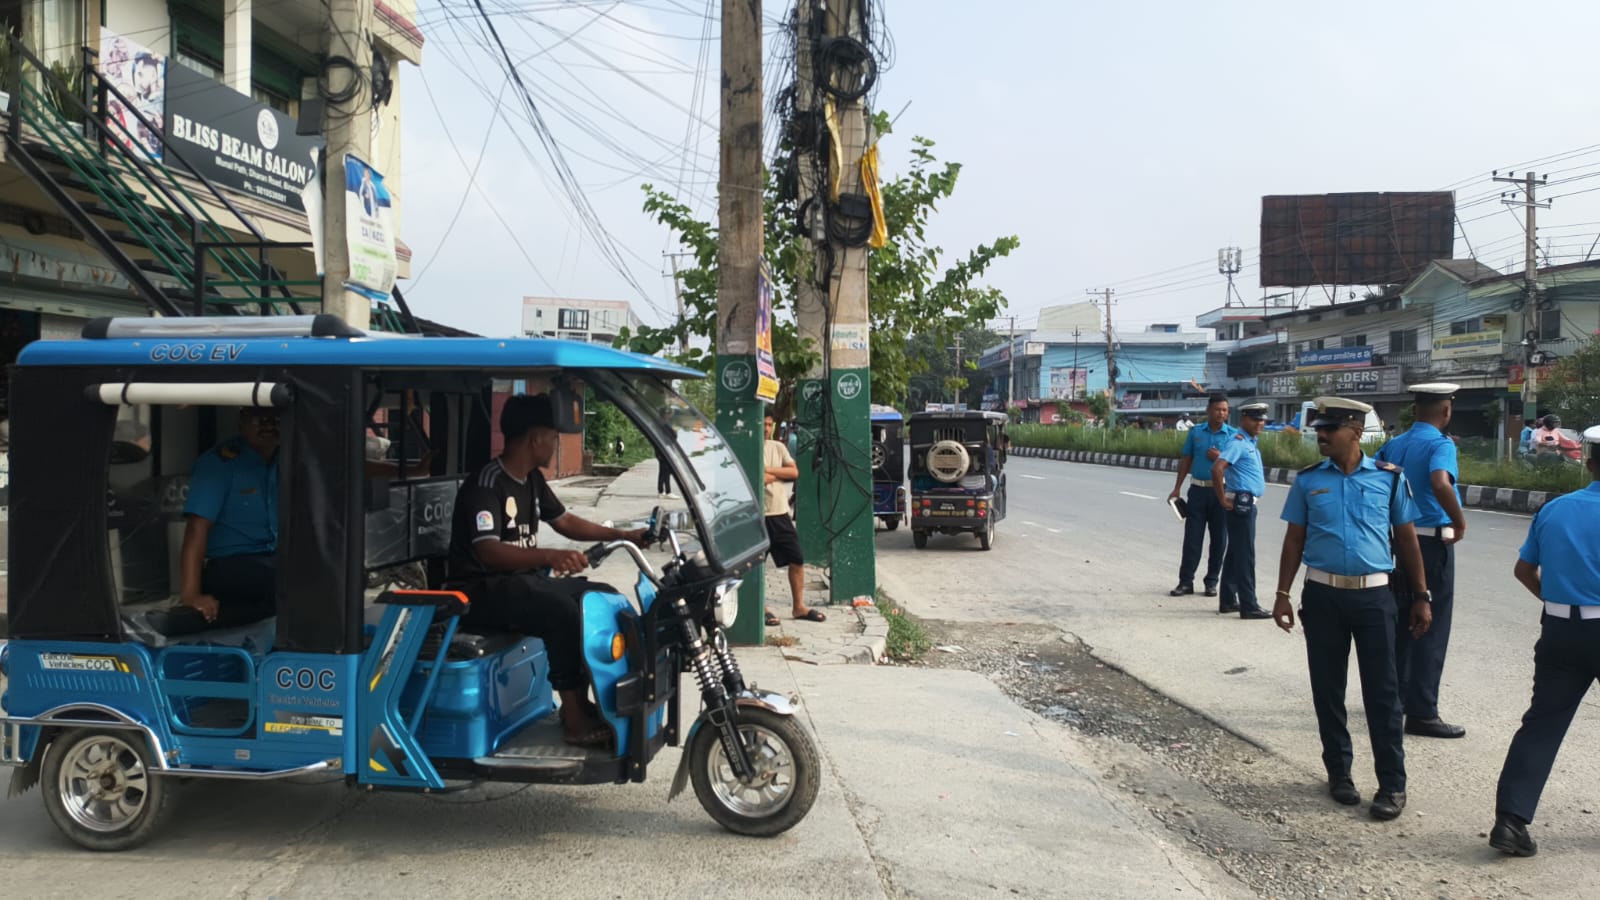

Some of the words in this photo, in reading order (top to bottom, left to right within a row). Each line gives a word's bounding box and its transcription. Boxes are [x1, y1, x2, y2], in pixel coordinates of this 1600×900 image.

[173, 114, 218, 151] BLISS
[221, 133, 263, 168] BEAM
[265, 152, 306, 185] SALON
[151, 343, 205, 361] COC
[209, 343, 248, 361] EV
[49, 660, 85, 669] Vehicles
[85, 659, 111, 670] COC
[276, 666, 336, 692] COC
